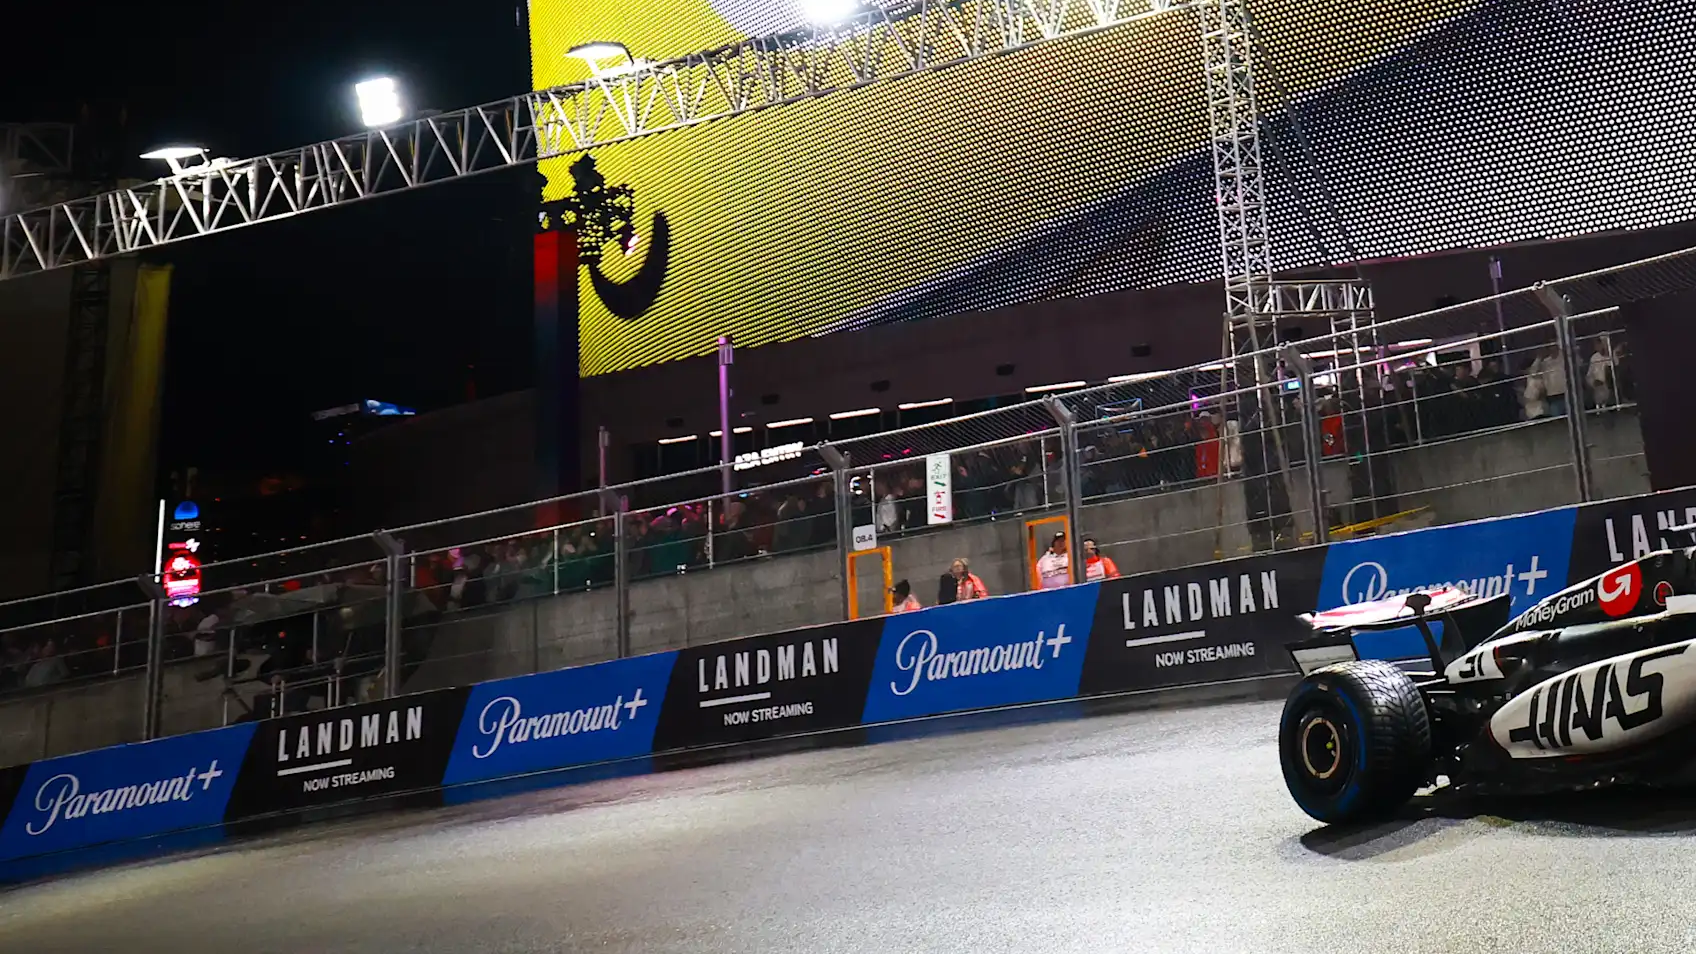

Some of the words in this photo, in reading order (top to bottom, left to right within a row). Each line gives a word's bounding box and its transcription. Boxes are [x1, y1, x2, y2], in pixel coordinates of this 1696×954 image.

[1122, 569, 1280, 630] LANDMAN
[1514, 587, 1595, 631] MoneyGram
[698, 637, 840, 693] LANDMAN
[890, 623, 1072, 696] Paramount+
[1155, 650, 1184, 668] NOW
[1186, 642, 1255, 664] STREAMING
[472, 688, 648, 759] Paramount+
[723, 710, 749, 726] NOW
[751, 701, 814, 723] STREAMING
[1509, 644, 1691, 749] HAAS
[278, 706, 423, 762] LANDMAN
[26, 760, 223, 836] Paramount+
[303, 778, 330, 792] NOW
[331, 766, 395, 788] STREAMING
